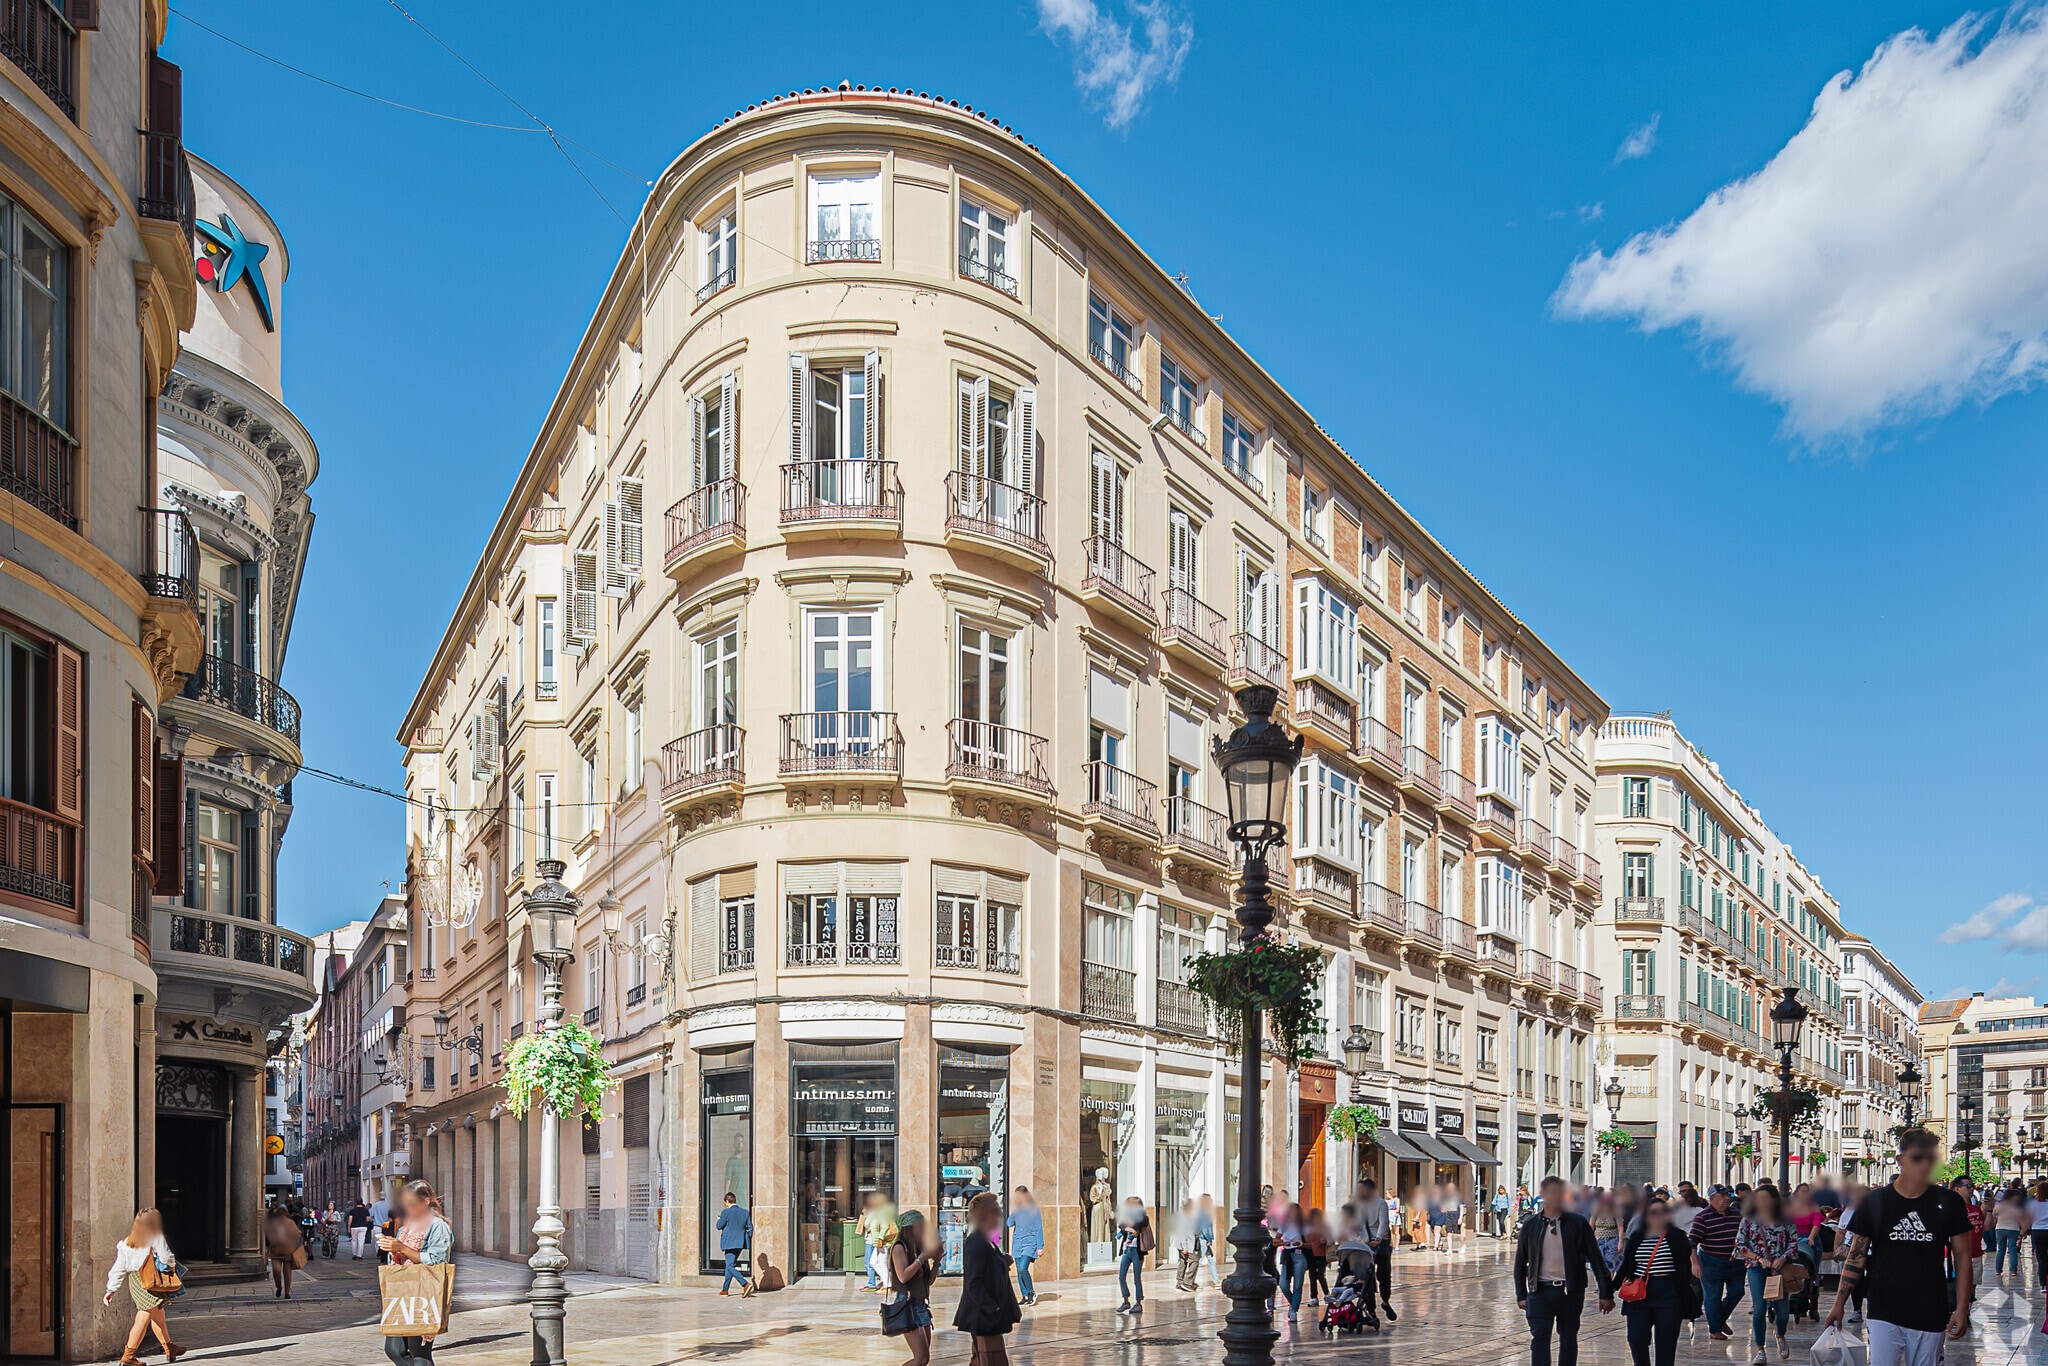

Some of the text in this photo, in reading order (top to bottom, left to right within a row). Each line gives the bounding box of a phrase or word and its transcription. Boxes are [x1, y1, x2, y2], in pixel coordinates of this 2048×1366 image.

[879, 903, 895, 911] ASV
[879, 924, 895, 933] ASV
[202, 1023, 253, 1043] CaixaBank
[702, 1094, 749, 1105] intimissimi
[795, 1089, 891, 1100] intimissimi
[865, 1105, 890, 1113] uomo
[1080, 1096, 1135, 1111] ntimissimi
[1156, 1104, 1207, 1119] ntimissimi
[1402, 1108, 1428, 1124] CANDY
[1443, 1114, 1462, 1128] SHOP
[1889, 1230, 1933, 1241] adidas
[380, 1296, 441, 1326] ZARA
